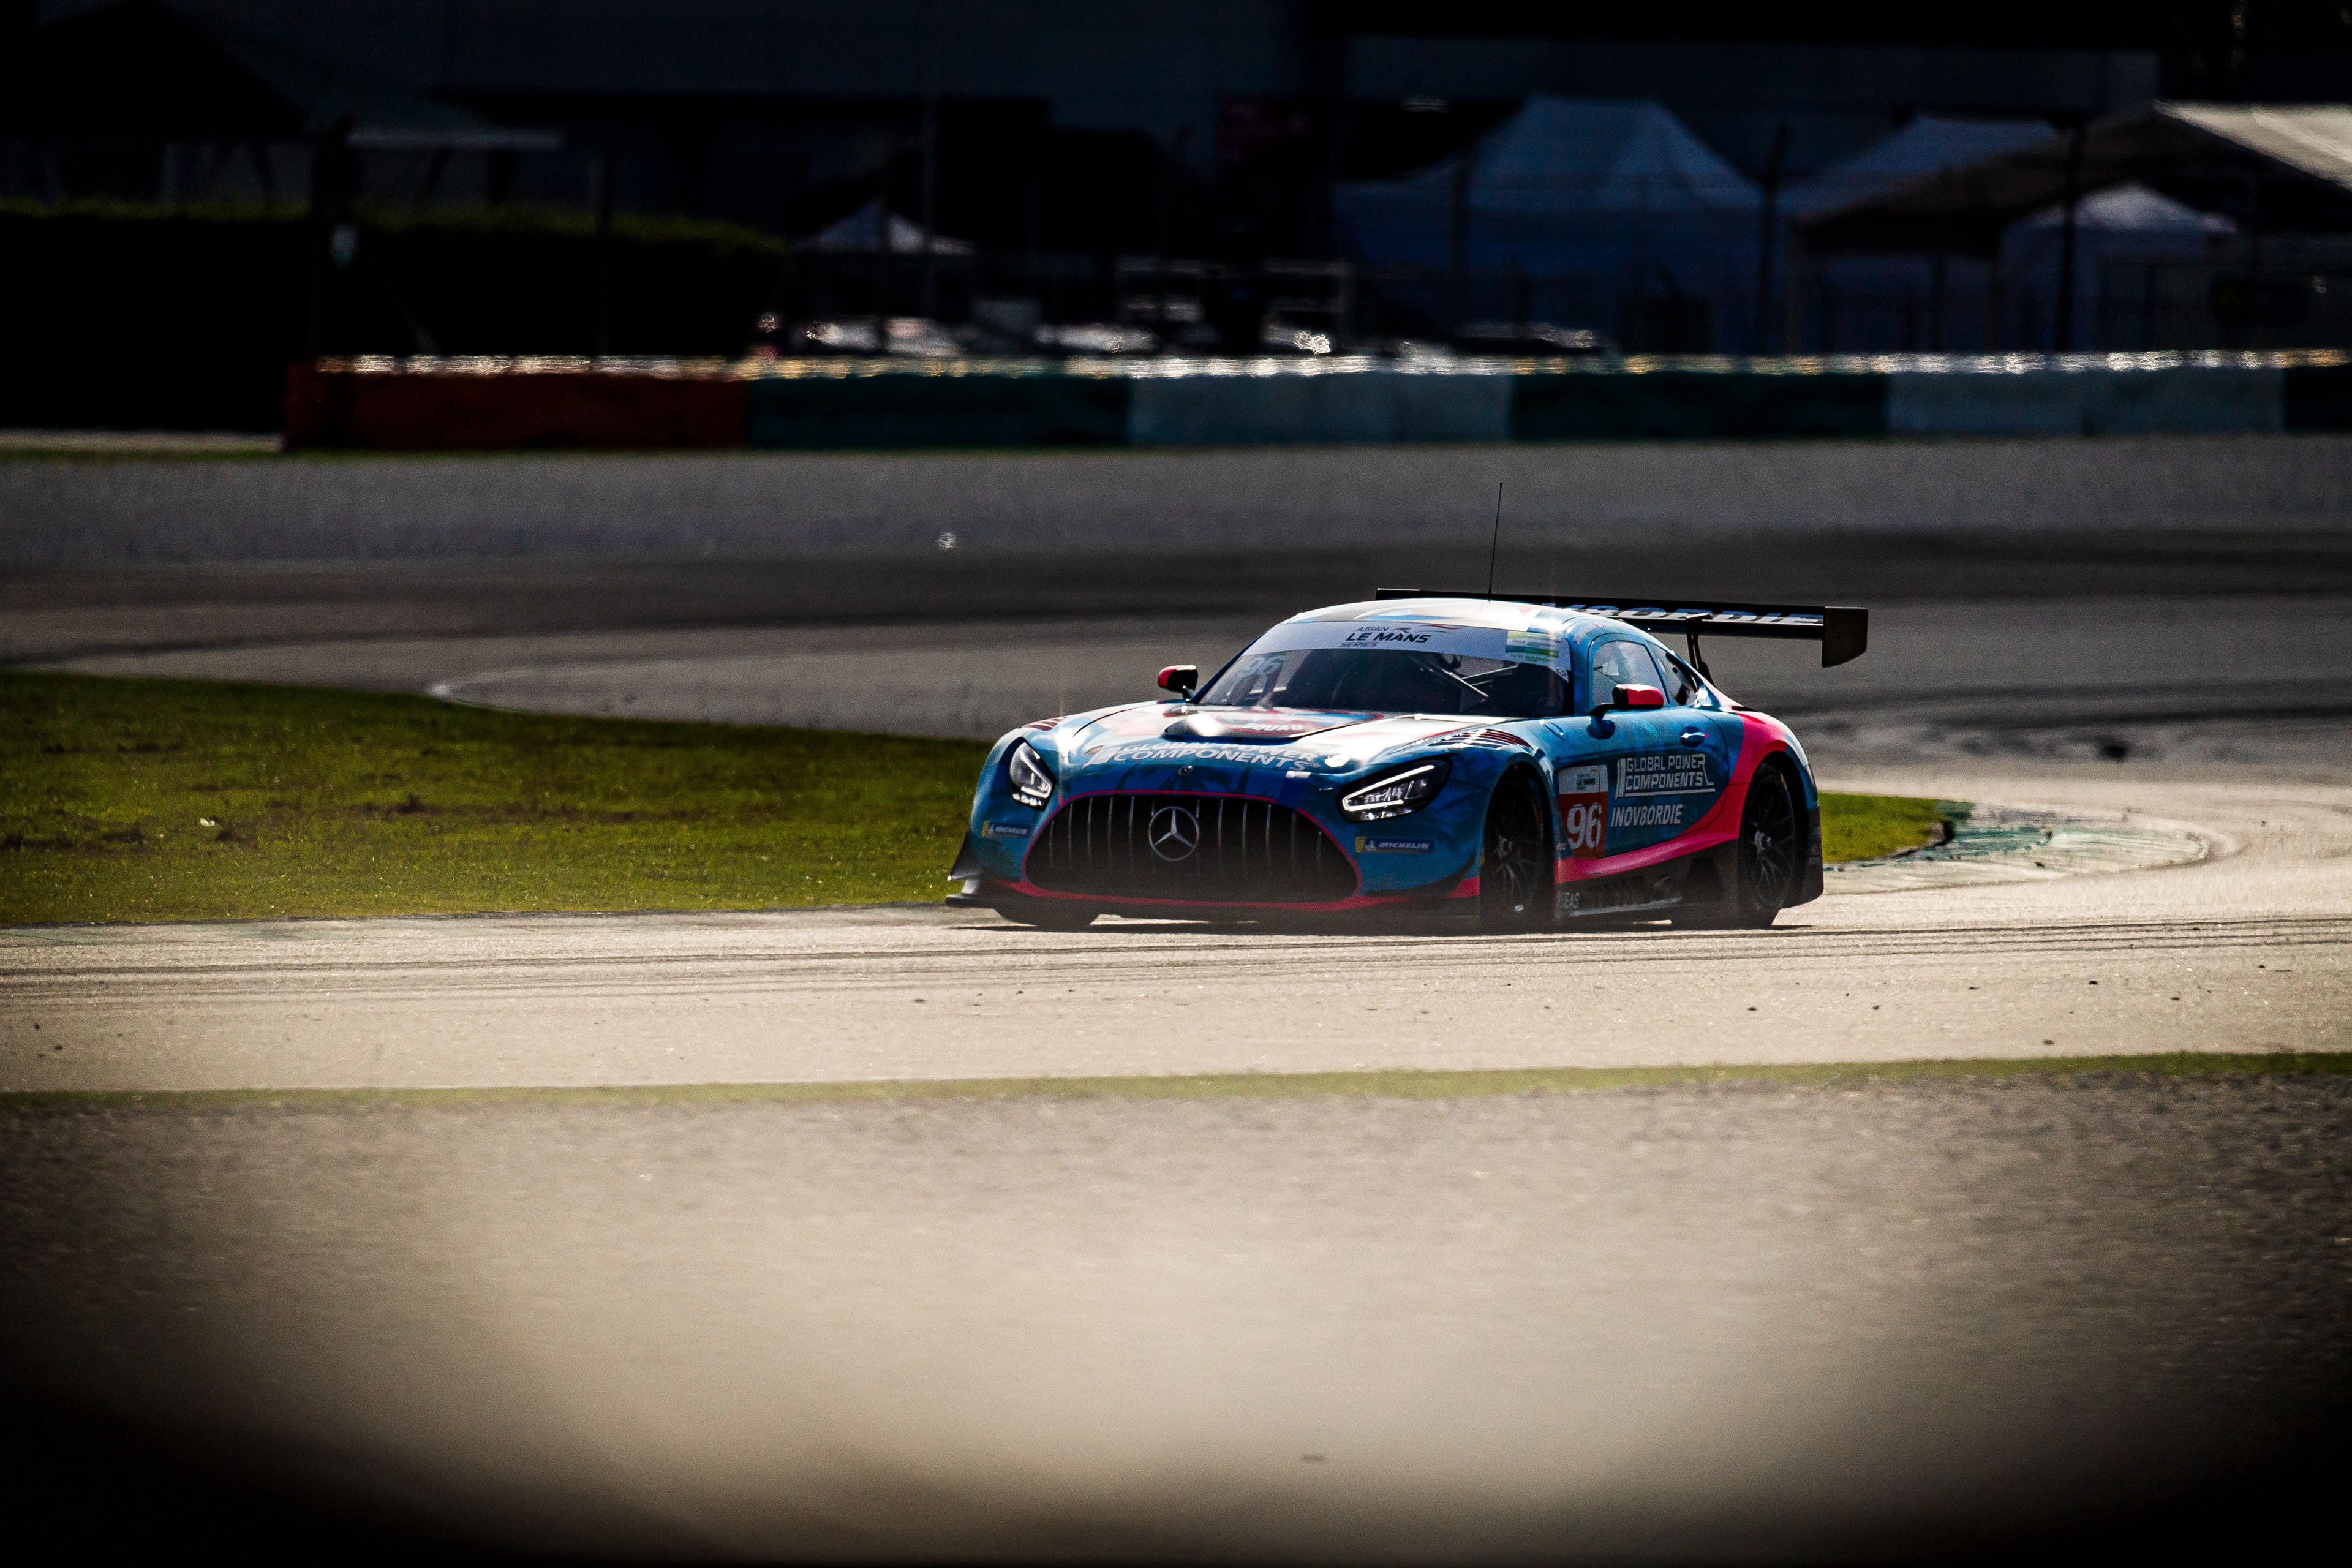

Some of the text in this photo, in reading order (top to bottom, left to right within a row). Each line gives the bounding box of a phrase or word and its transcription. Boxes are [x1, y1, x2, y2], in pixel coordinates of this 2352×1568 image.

[1346, 633, 1432, 643] LE MANS
[1113, 748, 1310, 771] COMPONENTS
[1123, 742, 1319, 761] GLOBAL POWER
[1626, 753, 1705, 772] GLOBAL POWER
[1626, 772, 1703, 790] COMPONENTS
[1611, 804, 1684, 827] INOV8ORDIE
[1567, 802, 1602, 849] 96
